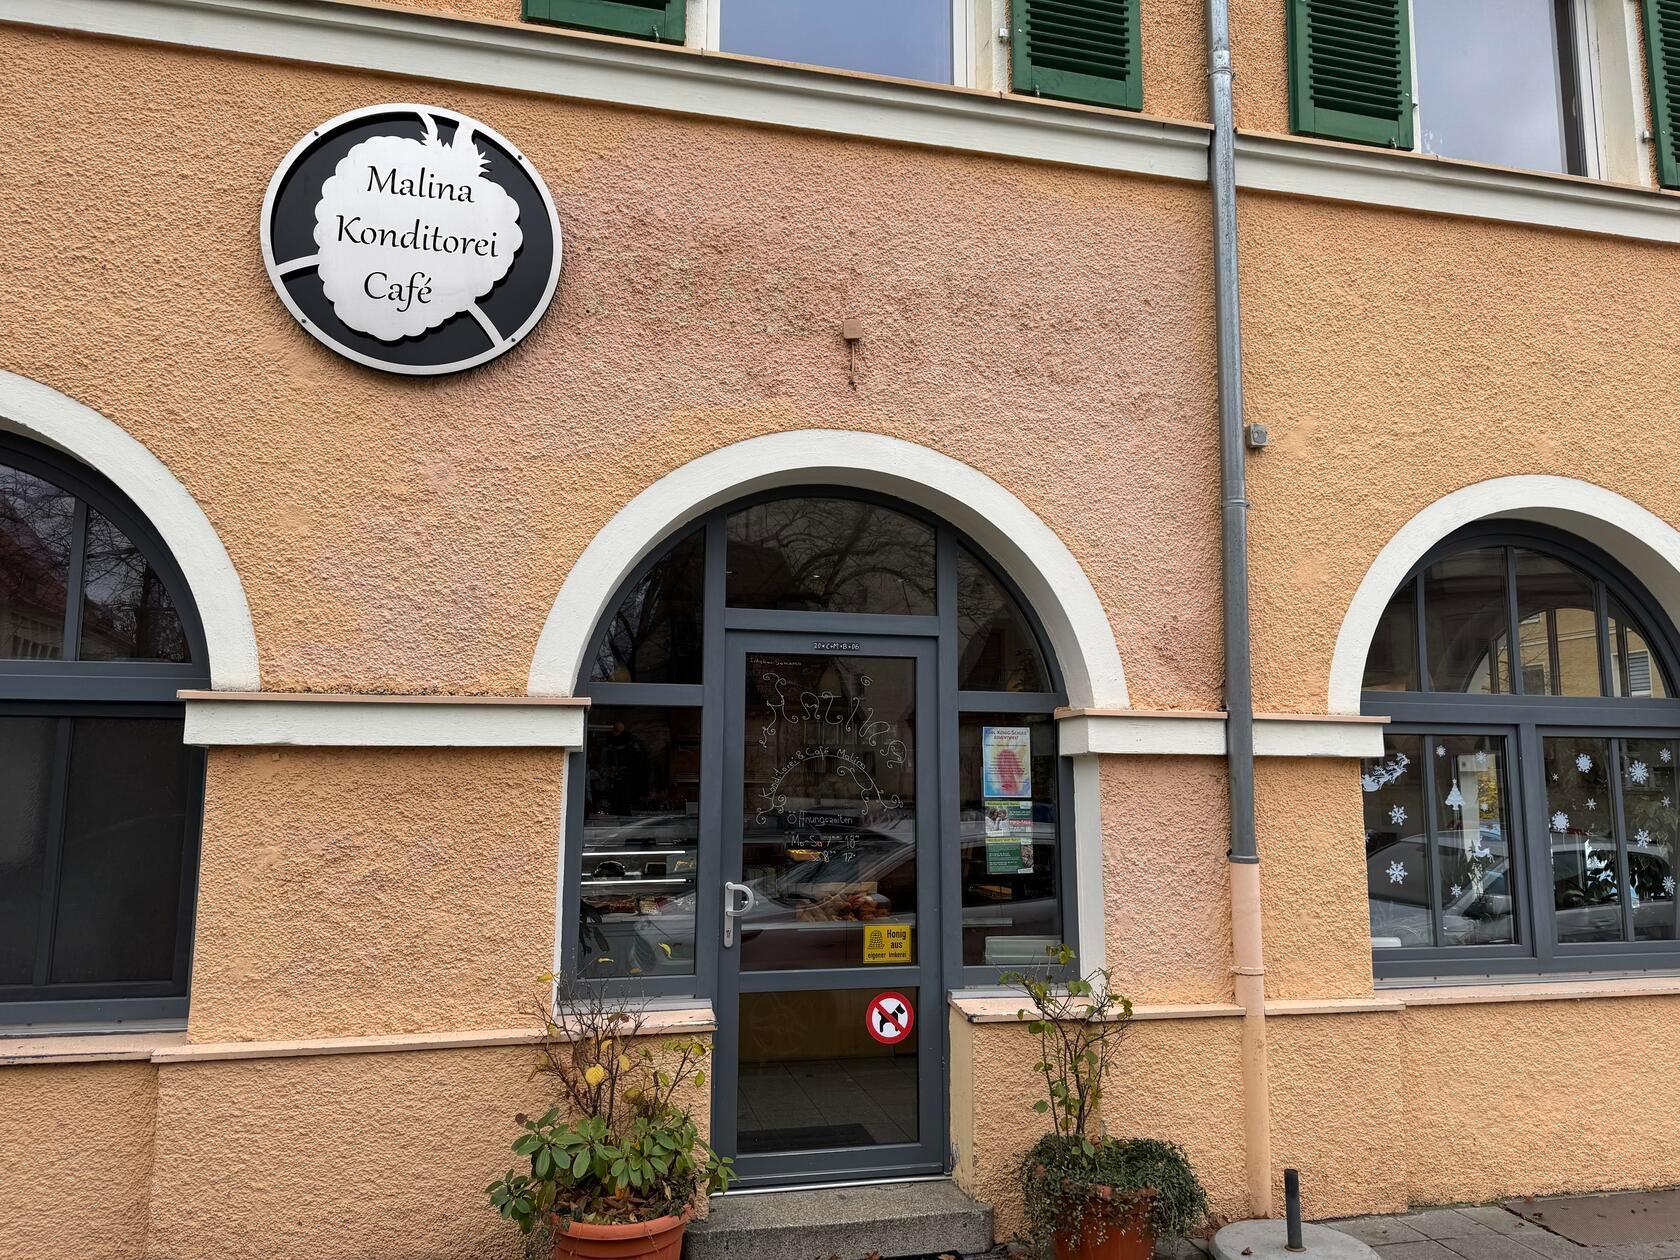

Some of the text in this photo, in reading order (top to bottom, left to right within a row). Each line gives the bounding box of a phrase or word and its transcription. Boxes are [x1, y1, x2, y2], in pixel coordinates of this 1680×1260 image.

[367, 165, 475, 203] Malina
[336, 214, 499, 258] Konditorei
[363, 271, 433, 313] Café
[806, 746, 830, 760] Café
[837, 748, 866, 769] Malina
[886, 929, 907, 940] Honig
[890, 941, 903, 949] aus
